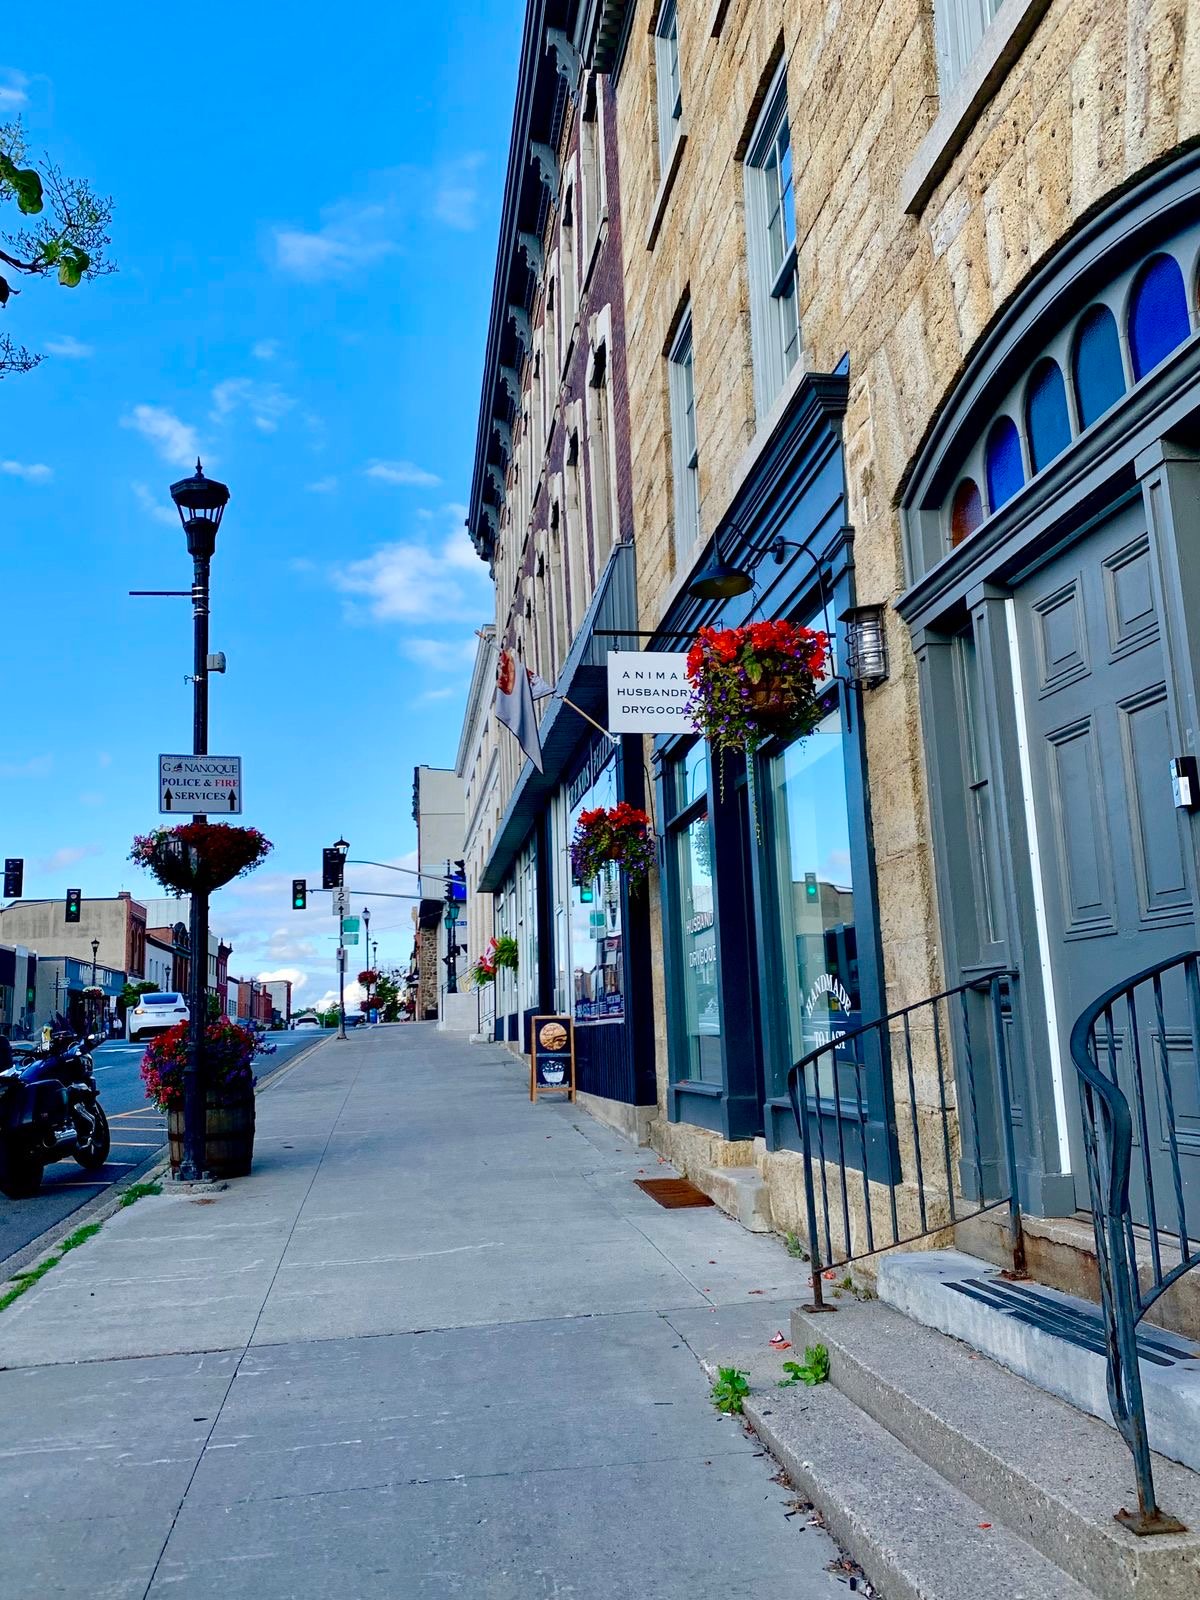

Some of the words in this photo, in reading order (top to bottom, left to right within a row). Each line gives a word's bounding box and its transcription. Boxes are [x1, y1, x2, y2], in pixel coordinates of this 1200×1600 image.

[622, 671, 689, 680] ANIMAL
[617, 688, 695, 697] HUSBANDRY
[622, 705, 684, 715] DRYGOOD
[162, 777, 200, 787] POLICE
[203, 779, 212, 787] &
[215, 779, 239, 787] FIRE
[175, 791, 226, 801] SERVICES
[337, 892, 345, 902] 2
[686, 911, 714, 936] HUSBAND
[806, 974, 852, 1019] HANDMADE
